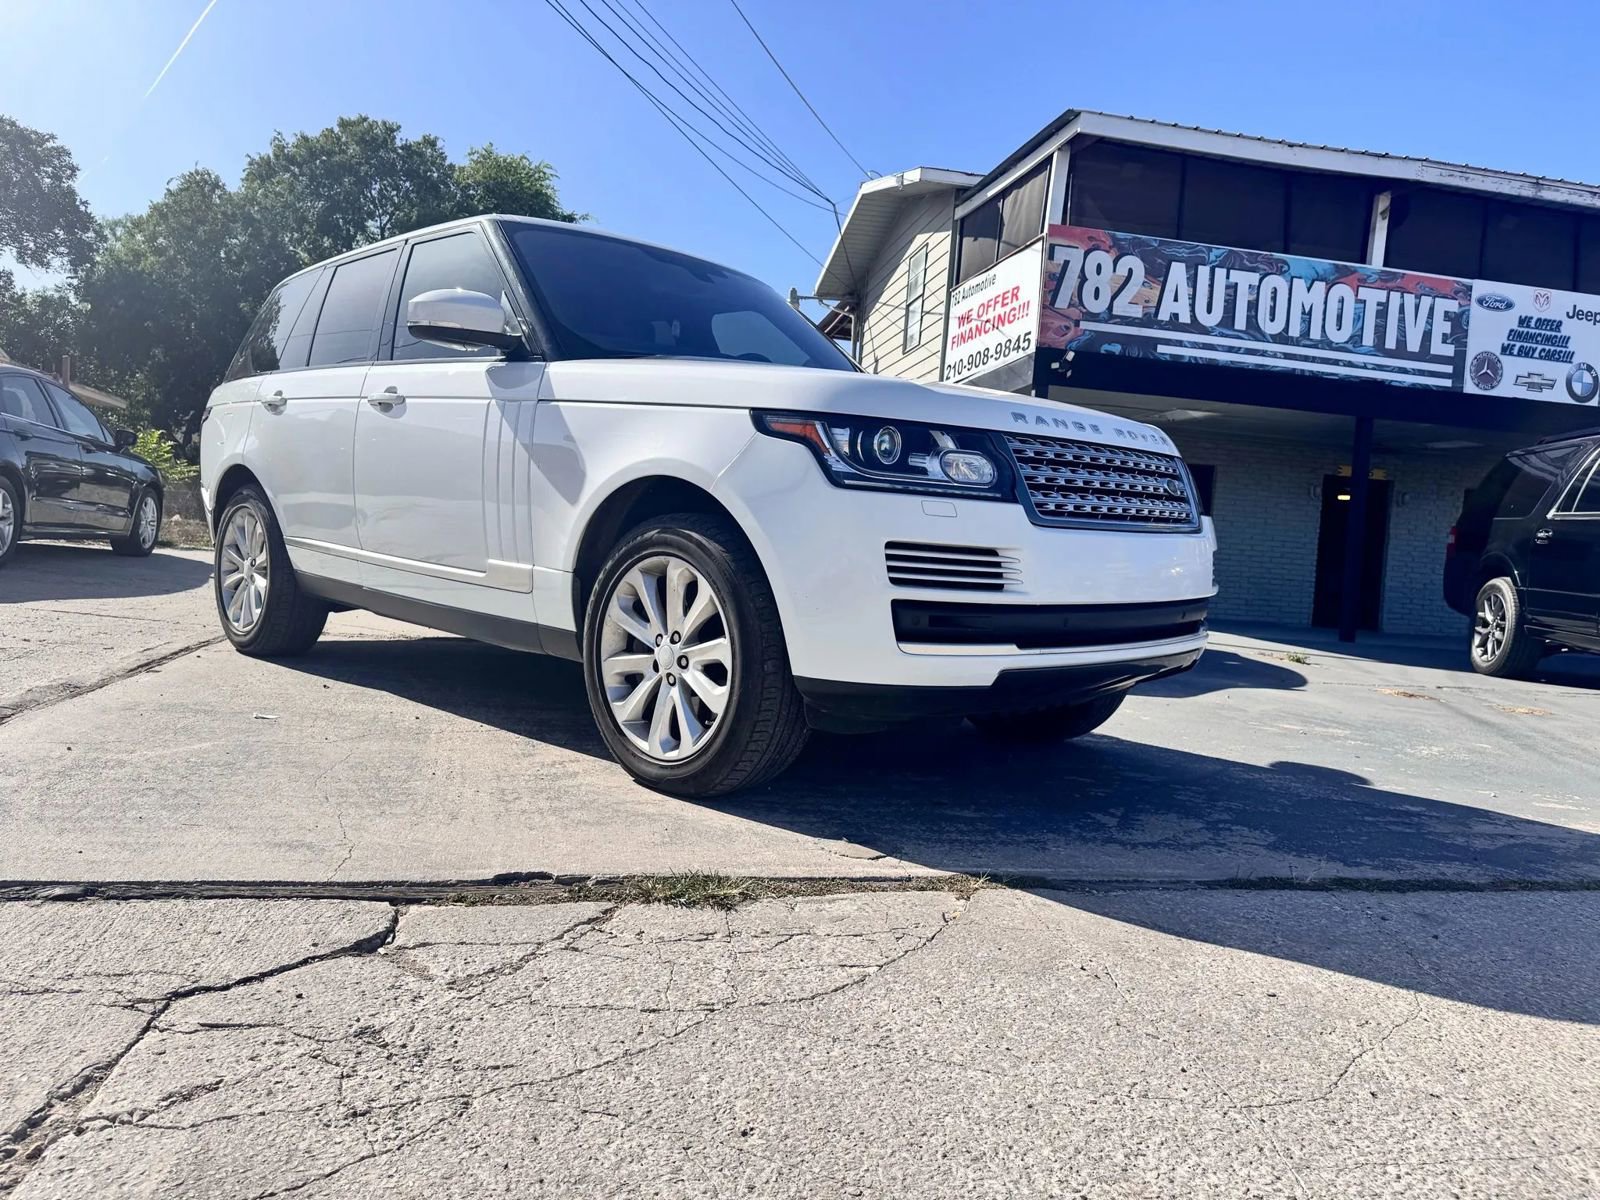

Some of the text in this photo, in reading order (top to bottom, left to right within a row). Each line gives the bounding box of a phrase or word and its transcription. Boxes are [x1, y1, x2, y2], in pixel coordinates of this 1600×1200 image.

[961, 274, 997, 302] Automotive
[957, 285, 1020, 329] WE OFFER
[1053, 246, 1460, 357] 782 AUTOMOTIVE
[1482, 295, 1507, 309] Ford
[951, 300, 1030, 351] FINANCING!!!
[1517, 315, 1563, 333] WE OFFER
[1566, 304, 1600, 326] Jeep
[1507, 329, 1571, 348] FINANCING!!!
[945, 331, 1032, 381] 210-908-9845
[1500, 342, 1575, 364] WE BUY CARS!!!
[1011, 411, 1102, 434] RANGE
